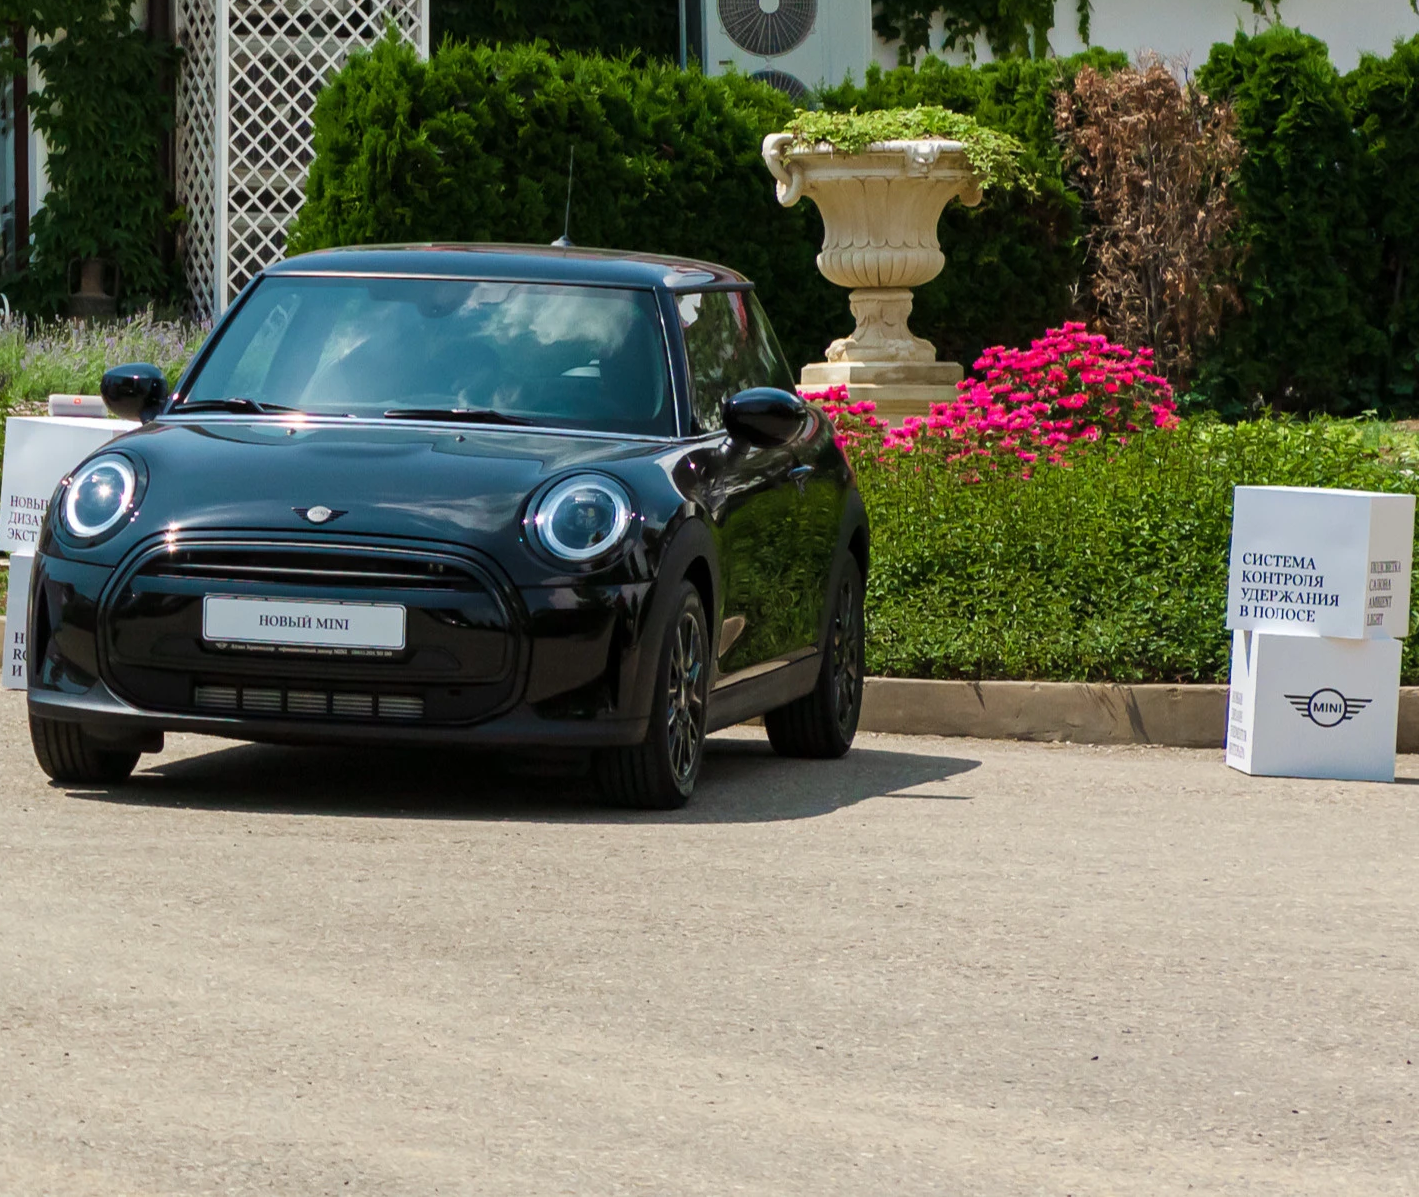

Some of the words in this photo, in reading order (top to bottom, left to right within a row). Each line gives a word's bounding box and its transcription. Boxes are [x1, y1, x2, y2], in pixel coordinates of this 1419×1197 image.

[8, 511, 44, 526] ДИЗА
[1242, 552, 1316, 570] СИСТЕМА
[1241, 570, 1324, 587] КОНТРОЛЯ
[1241, 587, 1339, 607] УДЕРЖАНИЯ
[259, 614, 312, 629] НОВЫЙ
[316, 617, 349, 630] MINI
[1239, 604, 1249, 617] В
[1253, 605, 1316, 623] ПОЛОСЕ
[1313, 702, 1343, 714] MINI
